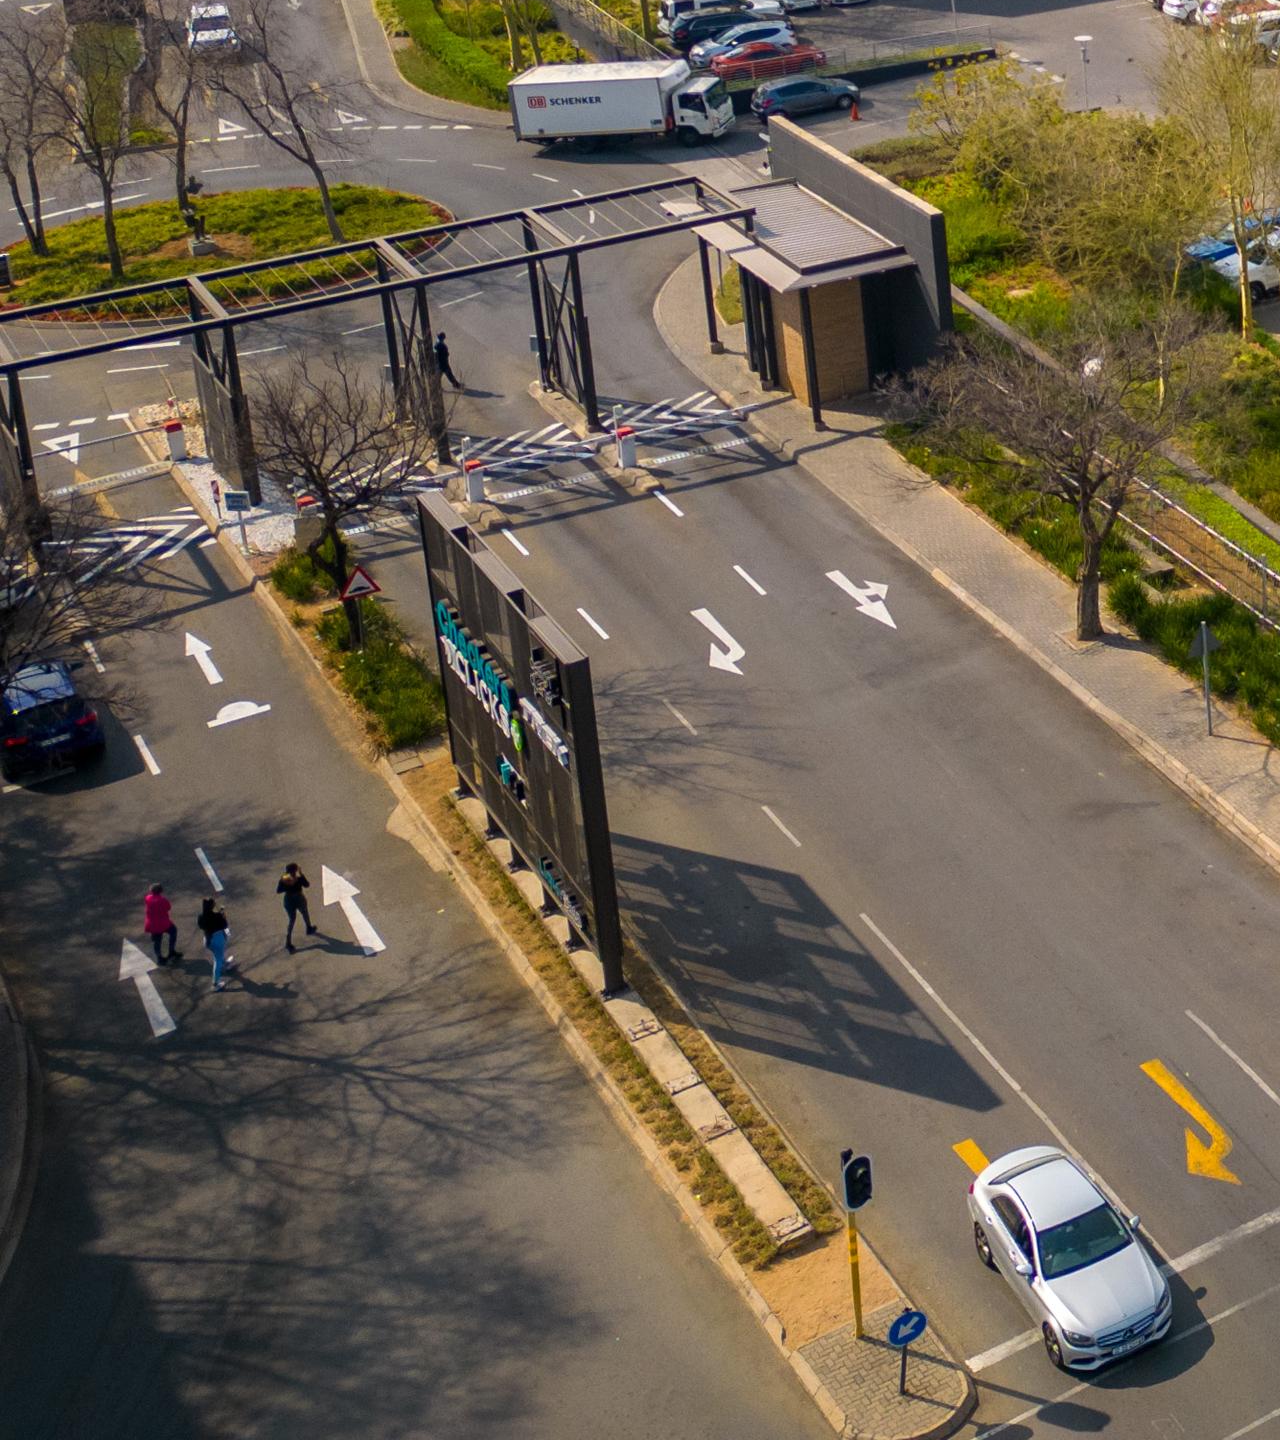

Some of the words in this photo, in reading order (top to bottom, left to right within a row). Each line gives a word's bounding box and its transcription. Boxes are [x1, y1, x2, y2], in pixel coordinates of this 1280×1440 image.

[529, 98, 545, 107] DB
[549, 96, 602, 106] SCHENKER
[436, 599, 512, 713] Checkers
[455, 650, 511, 738] CLICKS
